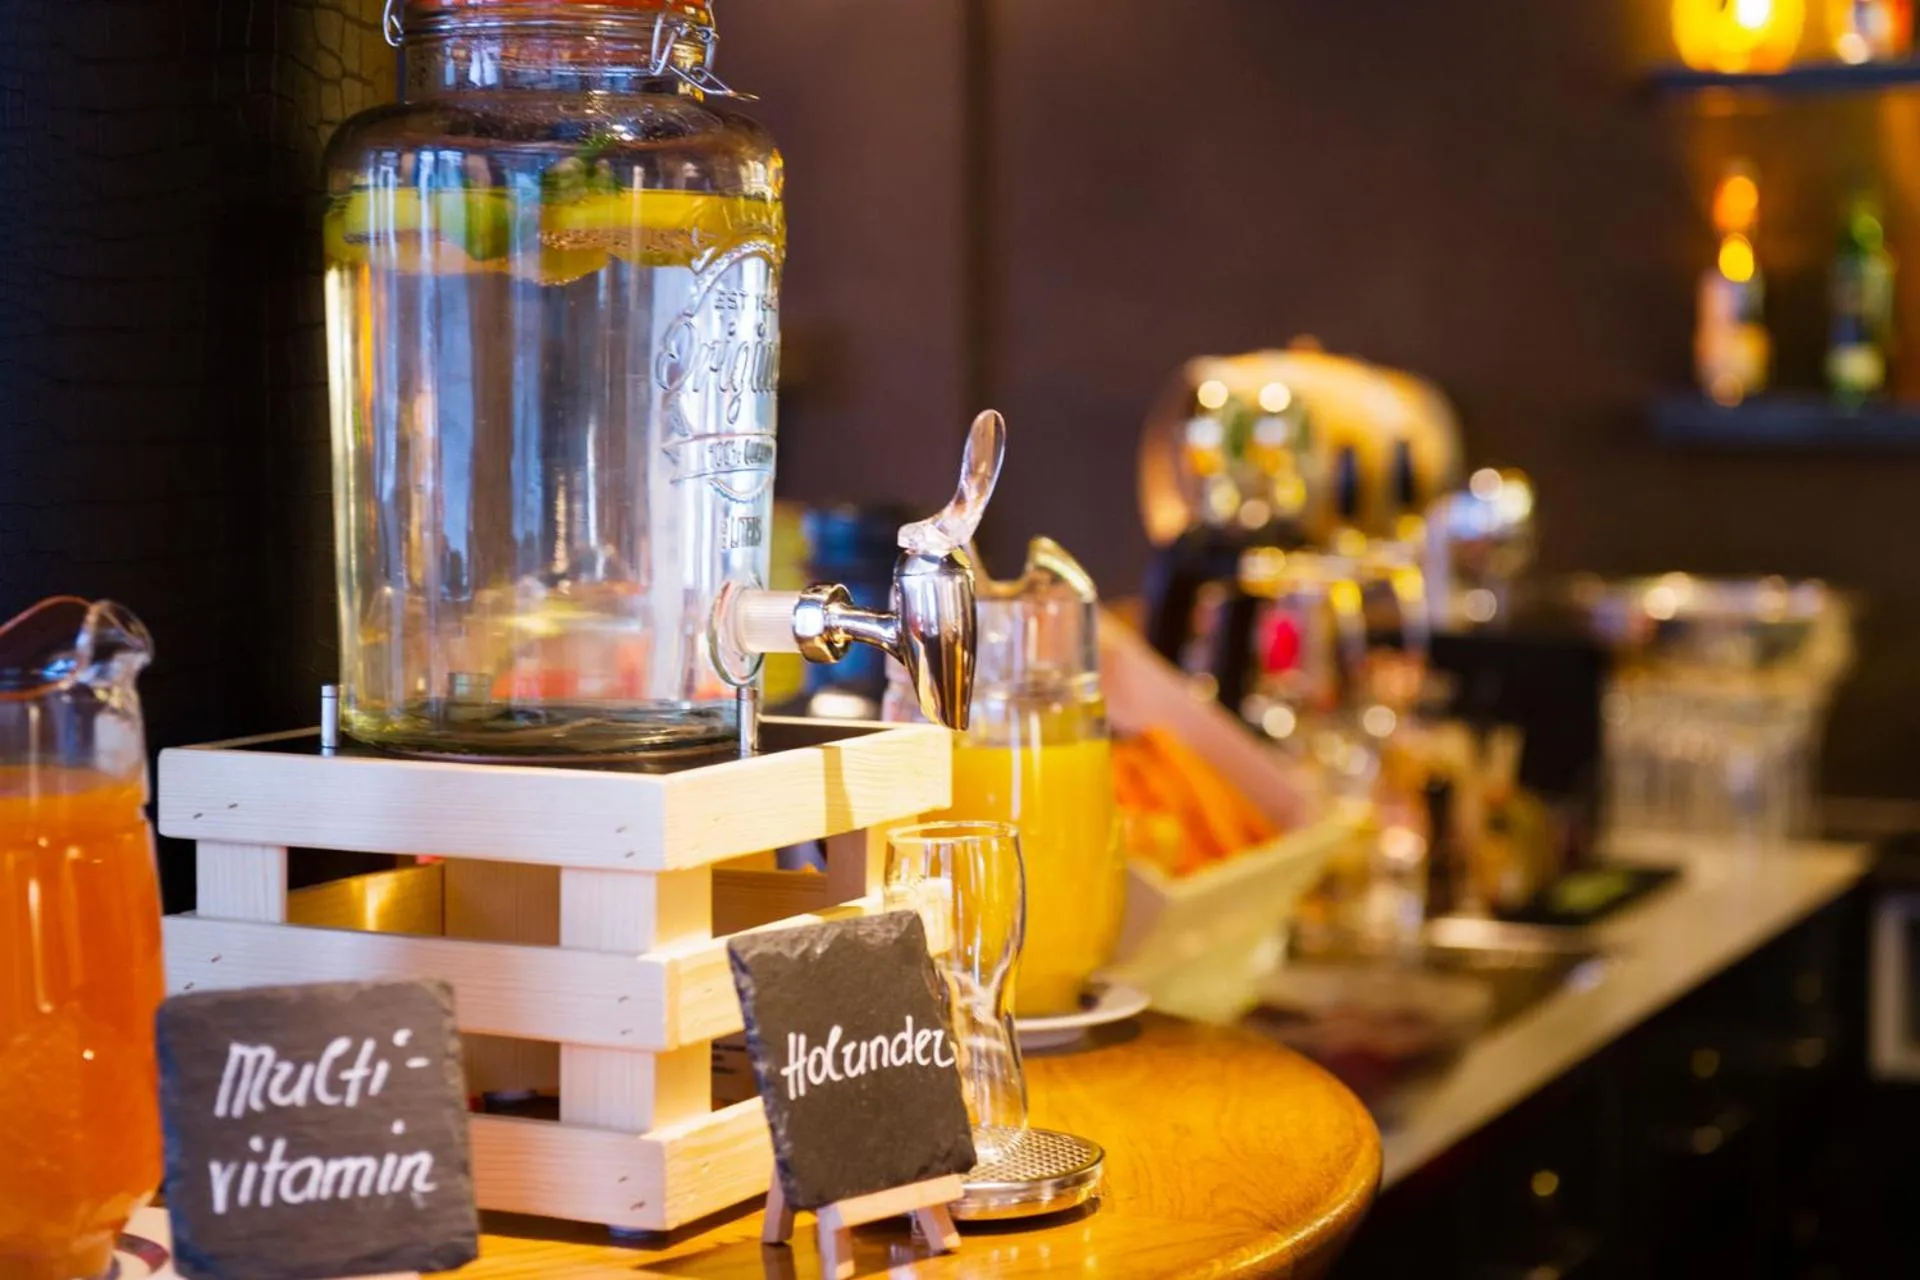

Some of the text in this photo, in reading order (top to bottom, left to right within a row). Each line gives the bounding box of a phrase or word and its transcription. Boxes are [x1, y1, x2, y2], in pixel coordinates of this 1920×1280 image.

[214, 1028, 430, 1119] Multi-
[780, 1014, 955, 1101] Holunder
[208, 1118, 439, 1215] vitamin
